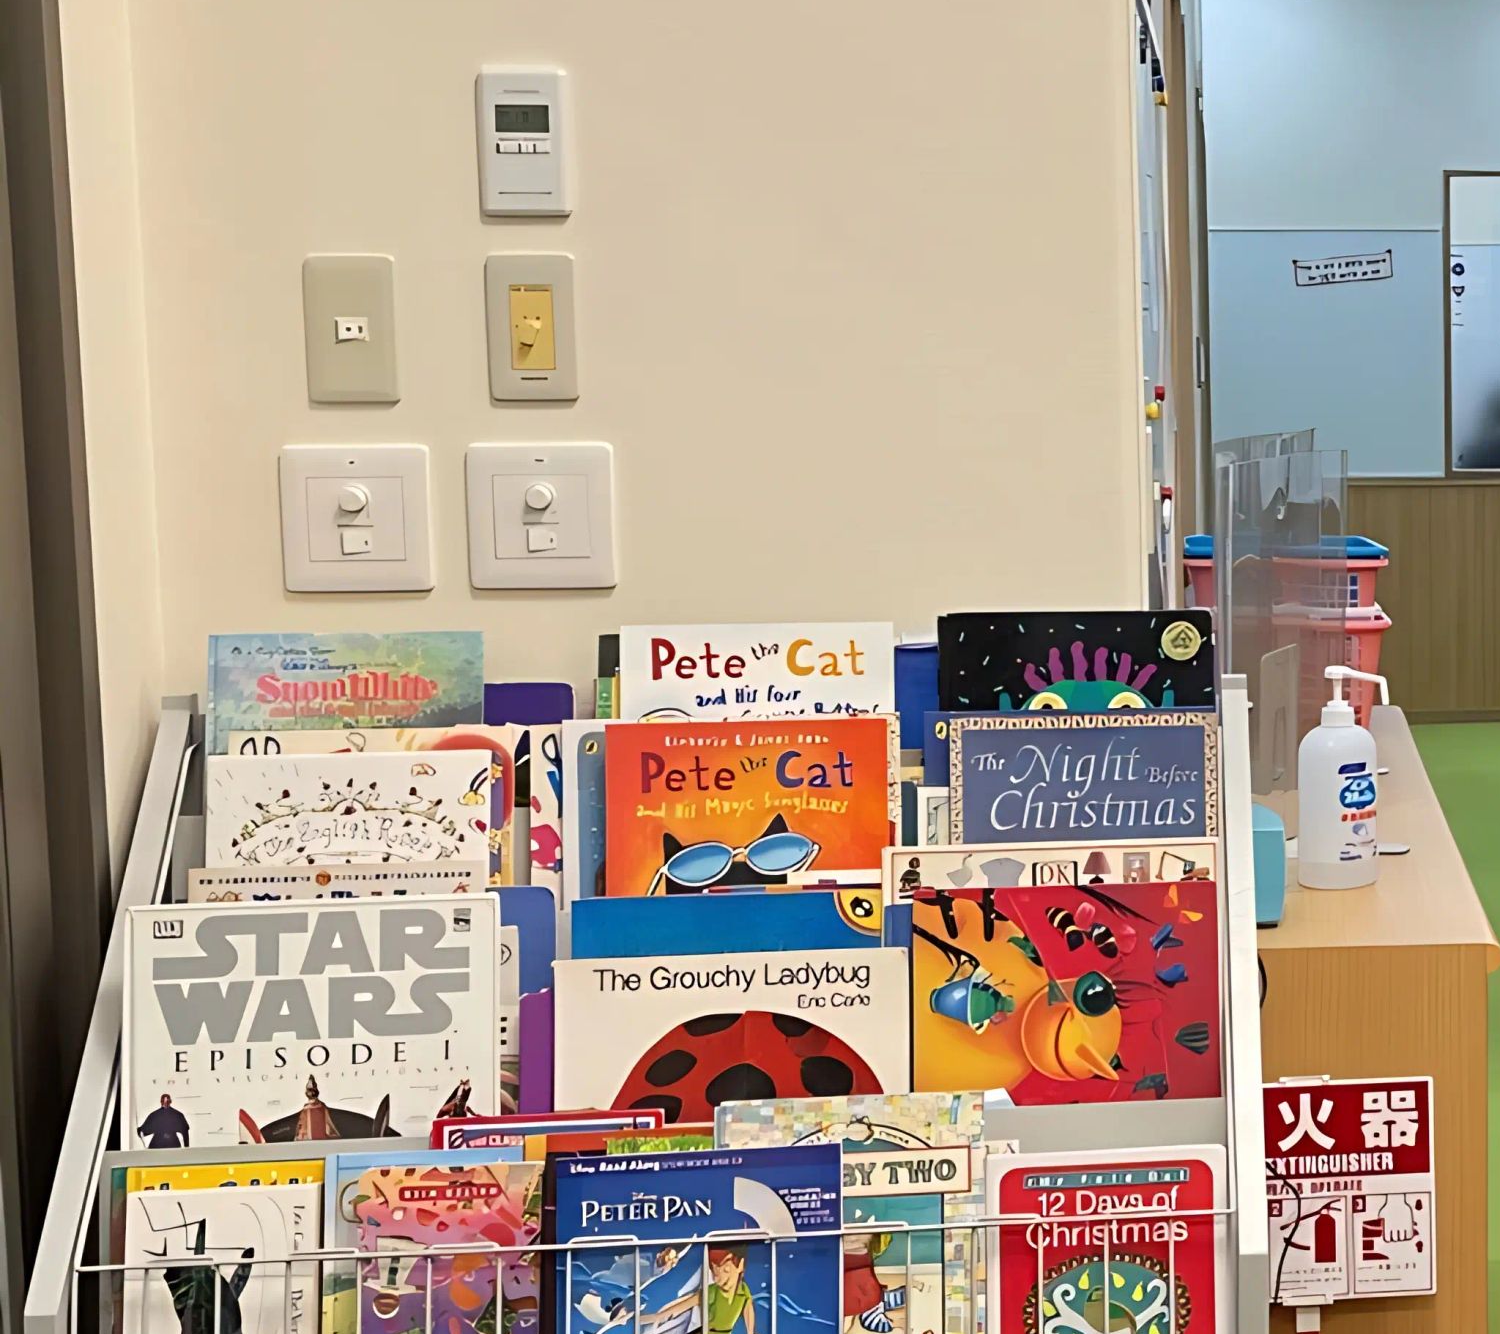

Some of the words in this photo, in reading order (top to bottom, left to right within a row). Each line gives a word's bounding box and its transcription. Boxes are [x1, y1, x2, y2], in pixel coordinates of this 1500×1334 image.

[650, 637, 746, 680] Pete
[786, 638, 865, 677] Cat
[695, 687, 727, 707] and
[640, 751, 736, 794] Pete
[775, 750, 854, 788] Cat
[970, 752, 1006, 772] The
[1009, 736, 1141, 798] Night
[1144, 764, 1199, 789] Before
[637, 804, 666, 818] and
[990, 781, 1197, 831] Christmas
[1039, 862, 1073, 886] DK
[152, 908, 471, 981] STAR
[592, 967, 642, 993] The
[649, 964, 757, 993] Grouchy
[764, 961, 872, 990] Ladybug
[153, 971, 471, 1046] WARS
[174, 1040, 408, 1073] EPISODE
[881, 1158, 958, 1185] TWO
[580, 1199, 658, 1229] PETER
[662, 1195, 712, 1223] PAN
[1037, 1191, 1065, 1217] 12
[1025, 1219, 1190, 1250] Christmas
